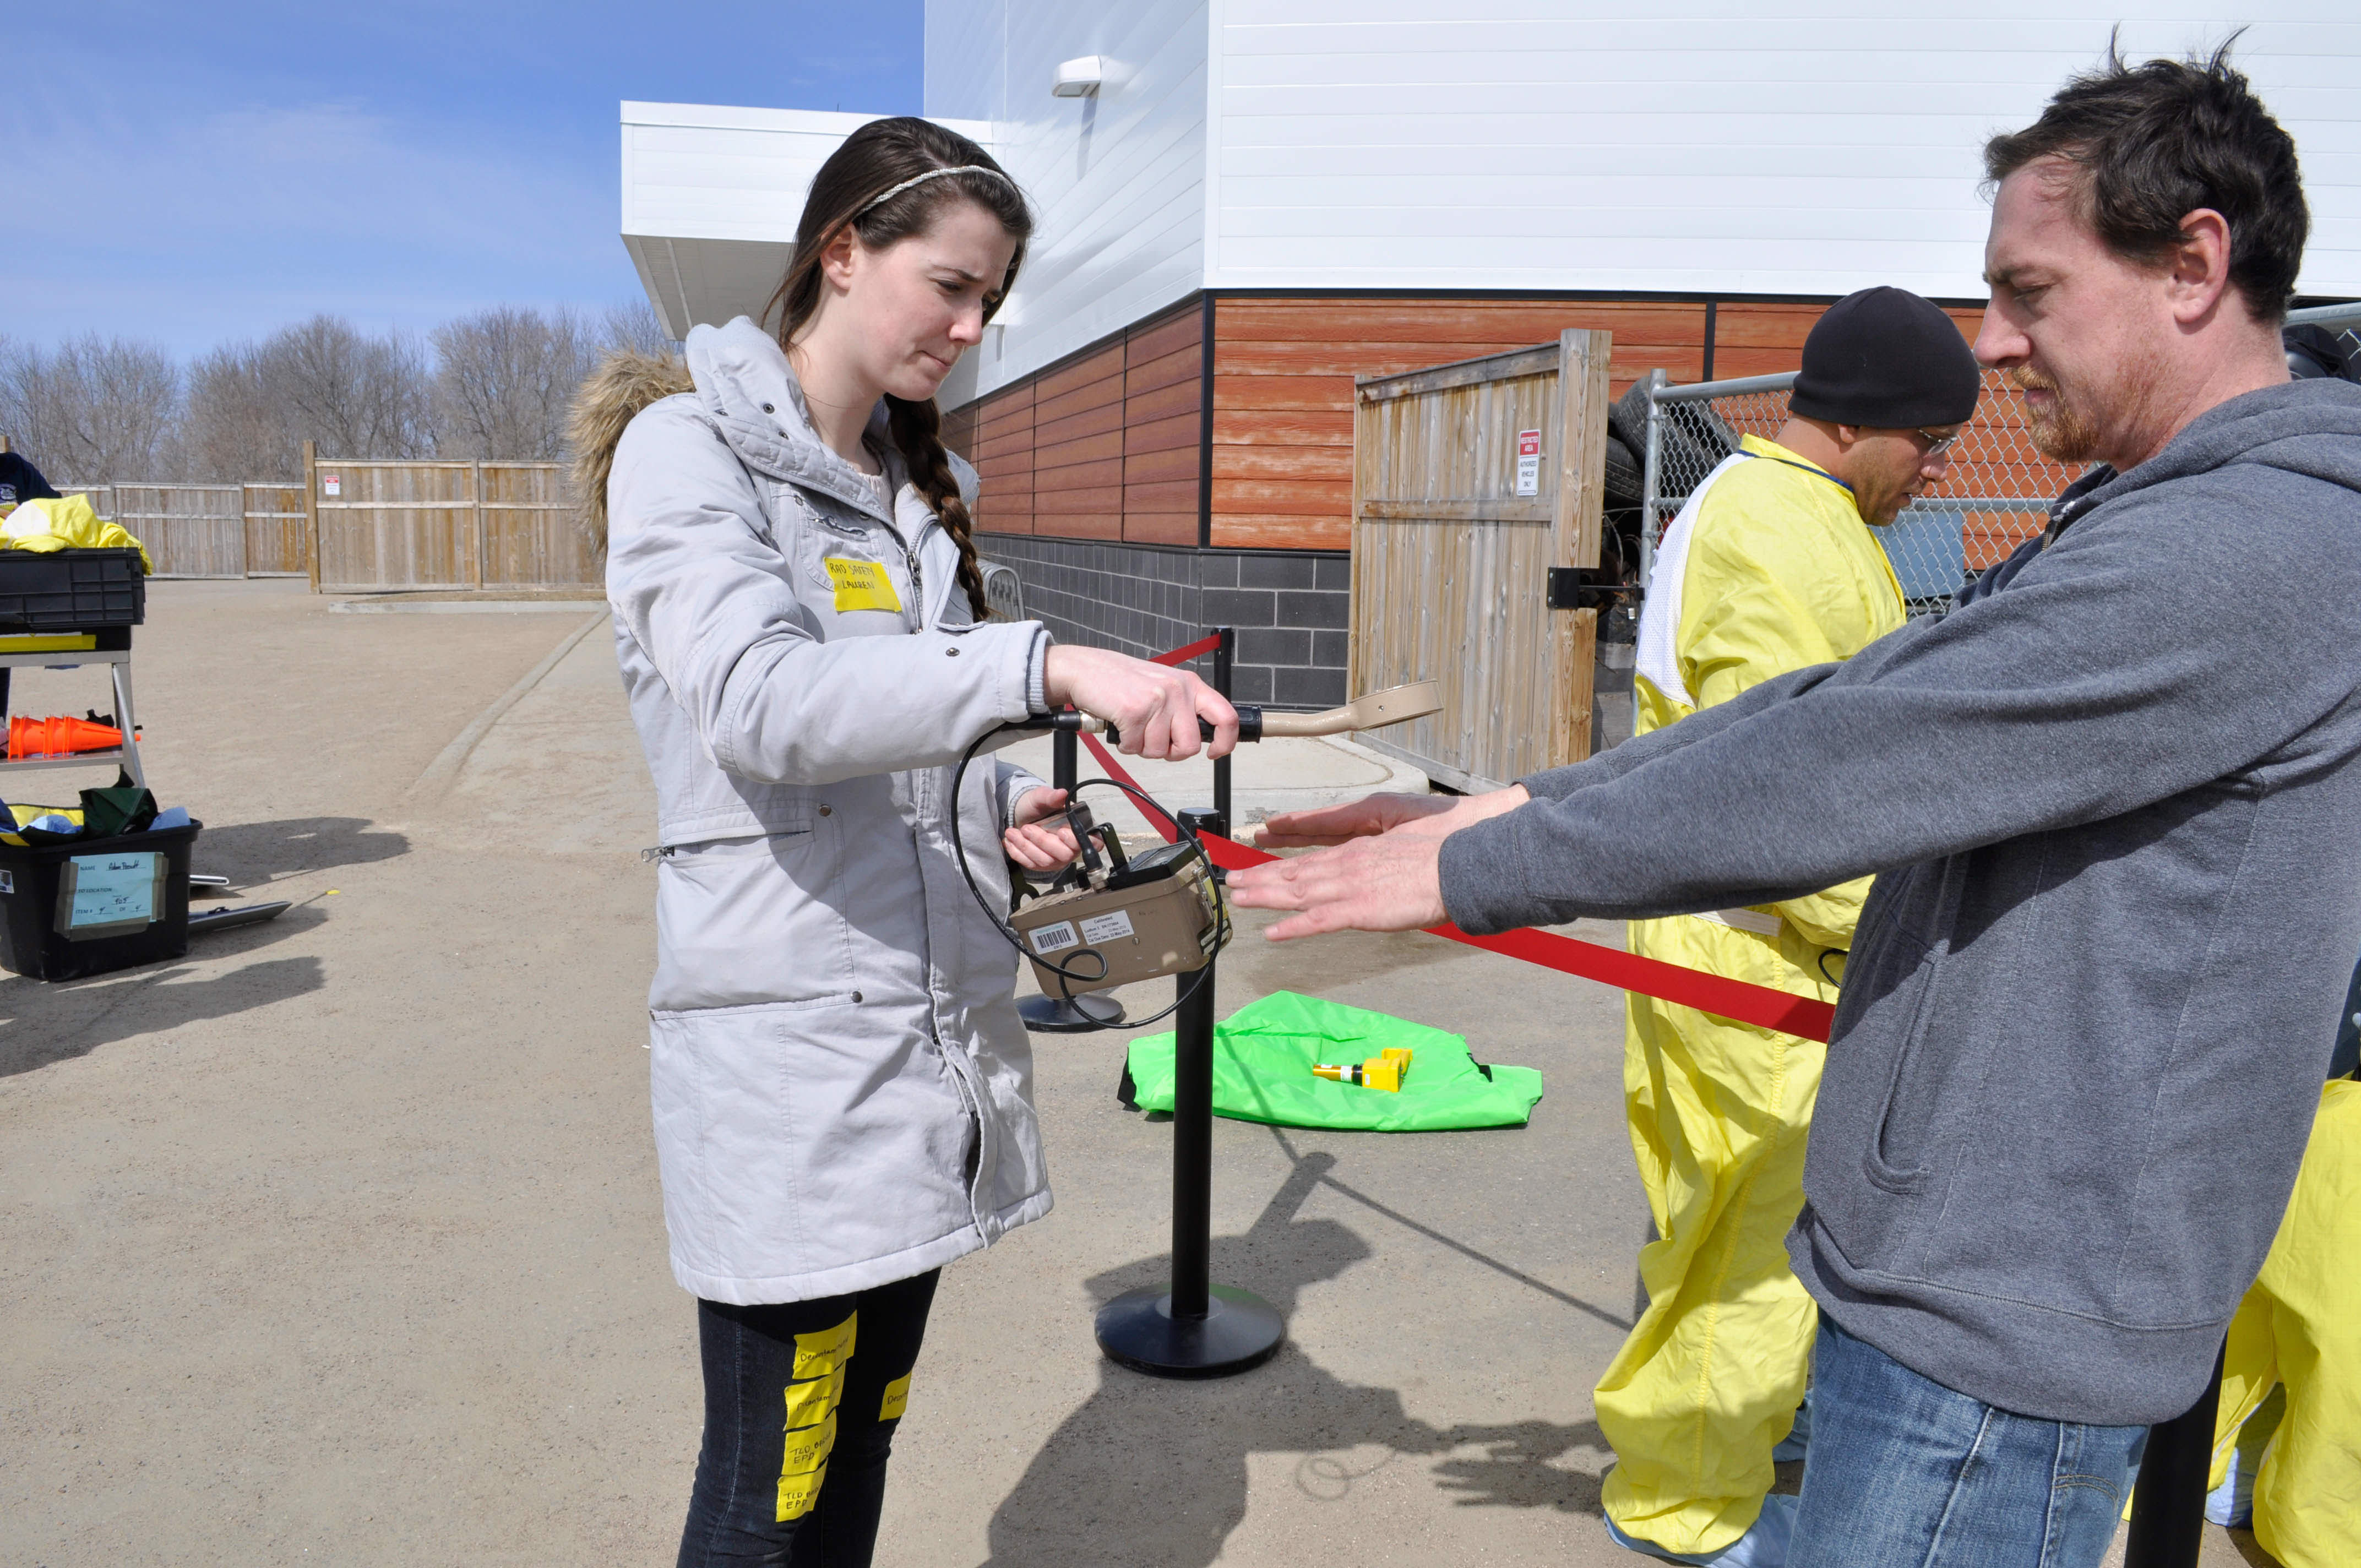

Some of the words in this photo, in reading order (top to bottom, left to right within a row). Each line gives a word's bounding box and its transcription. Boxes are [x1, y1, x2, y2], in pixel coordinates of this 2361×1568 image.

[829, 563, 846, 574] RAD
[848, 564, 875, 577] SAFETY
[841, 580, 875, 590] LAUREN
[789, 1445, 810, 1455] TLD
[794, 1452, 814, 1464] EPD
[787, 1499, 807, 1509] EPD
